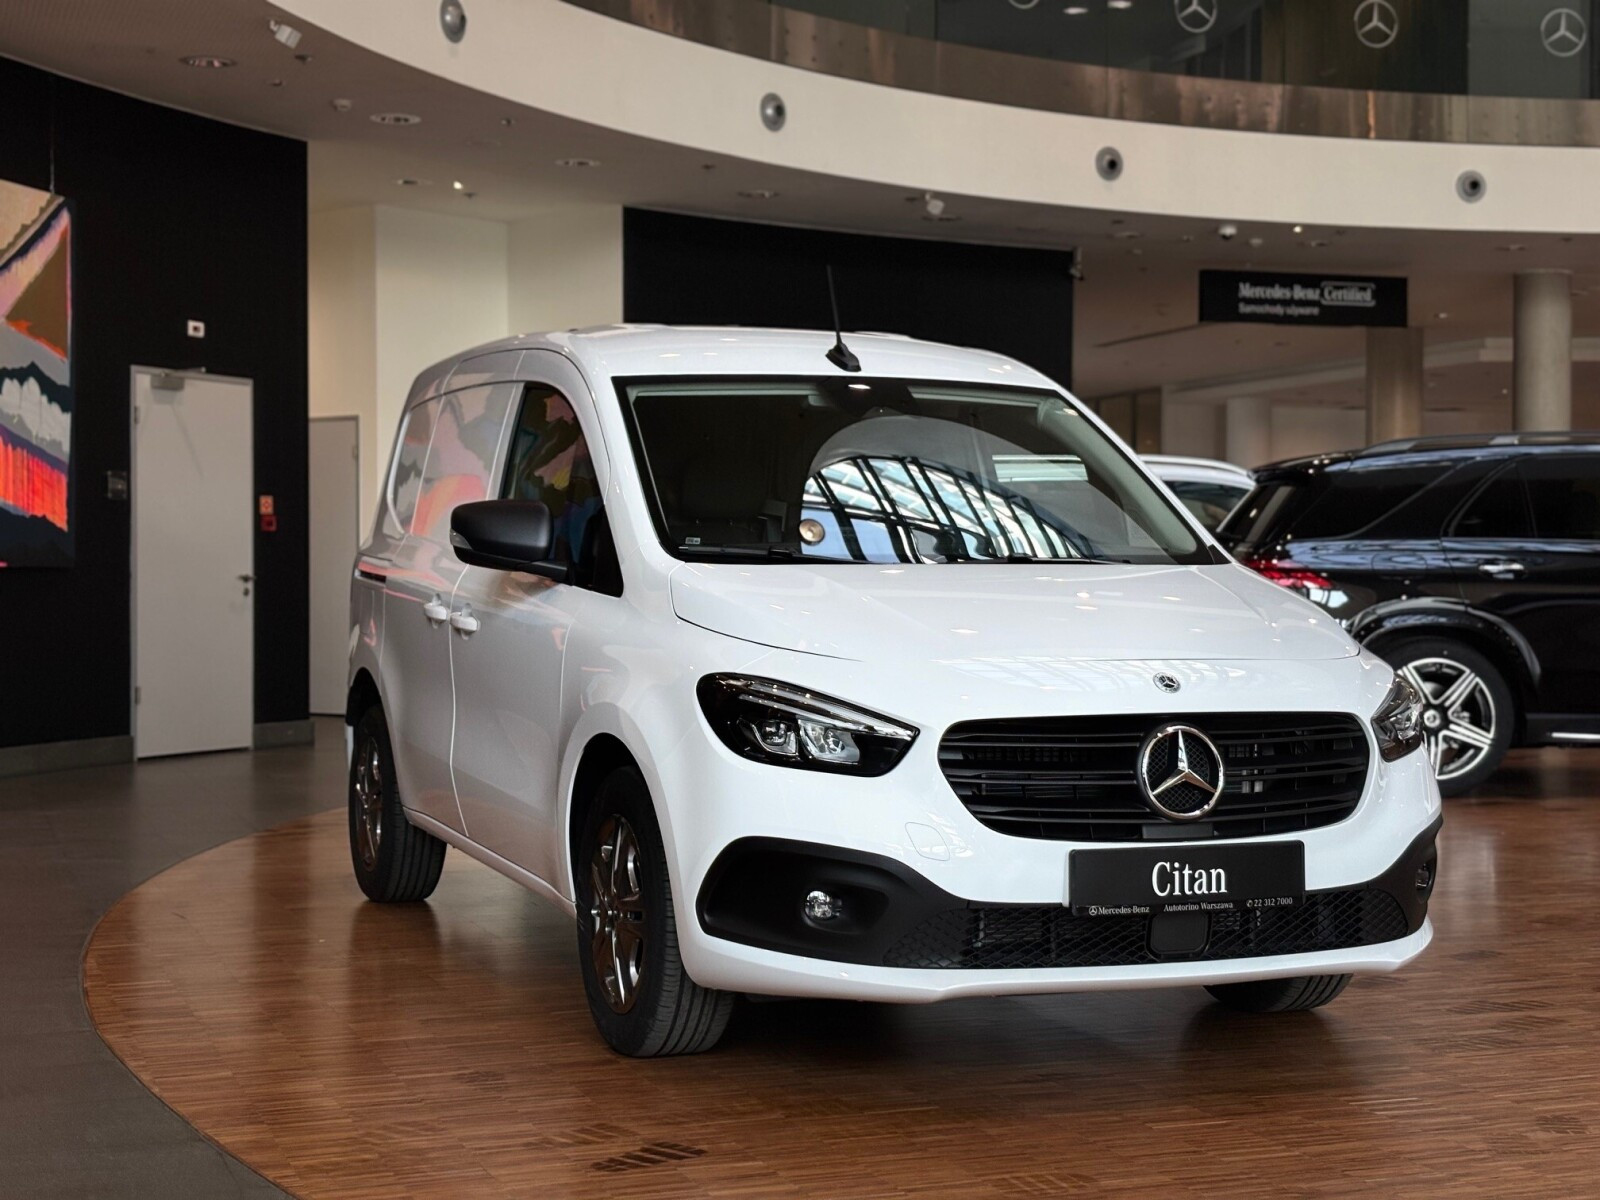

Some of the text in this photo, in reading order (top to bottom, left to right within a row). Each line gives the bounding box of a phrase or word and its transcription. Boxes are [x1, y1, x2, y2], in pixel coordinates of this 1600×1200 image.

[1151, 861, 1228, 897] Citan
[1163, 902, 1233, 912] Autotorino Warszawa
[1254, 897, 1293, 907] 22 312 7000
[1098, 905, 1150, 915] Mercedes-Benz
